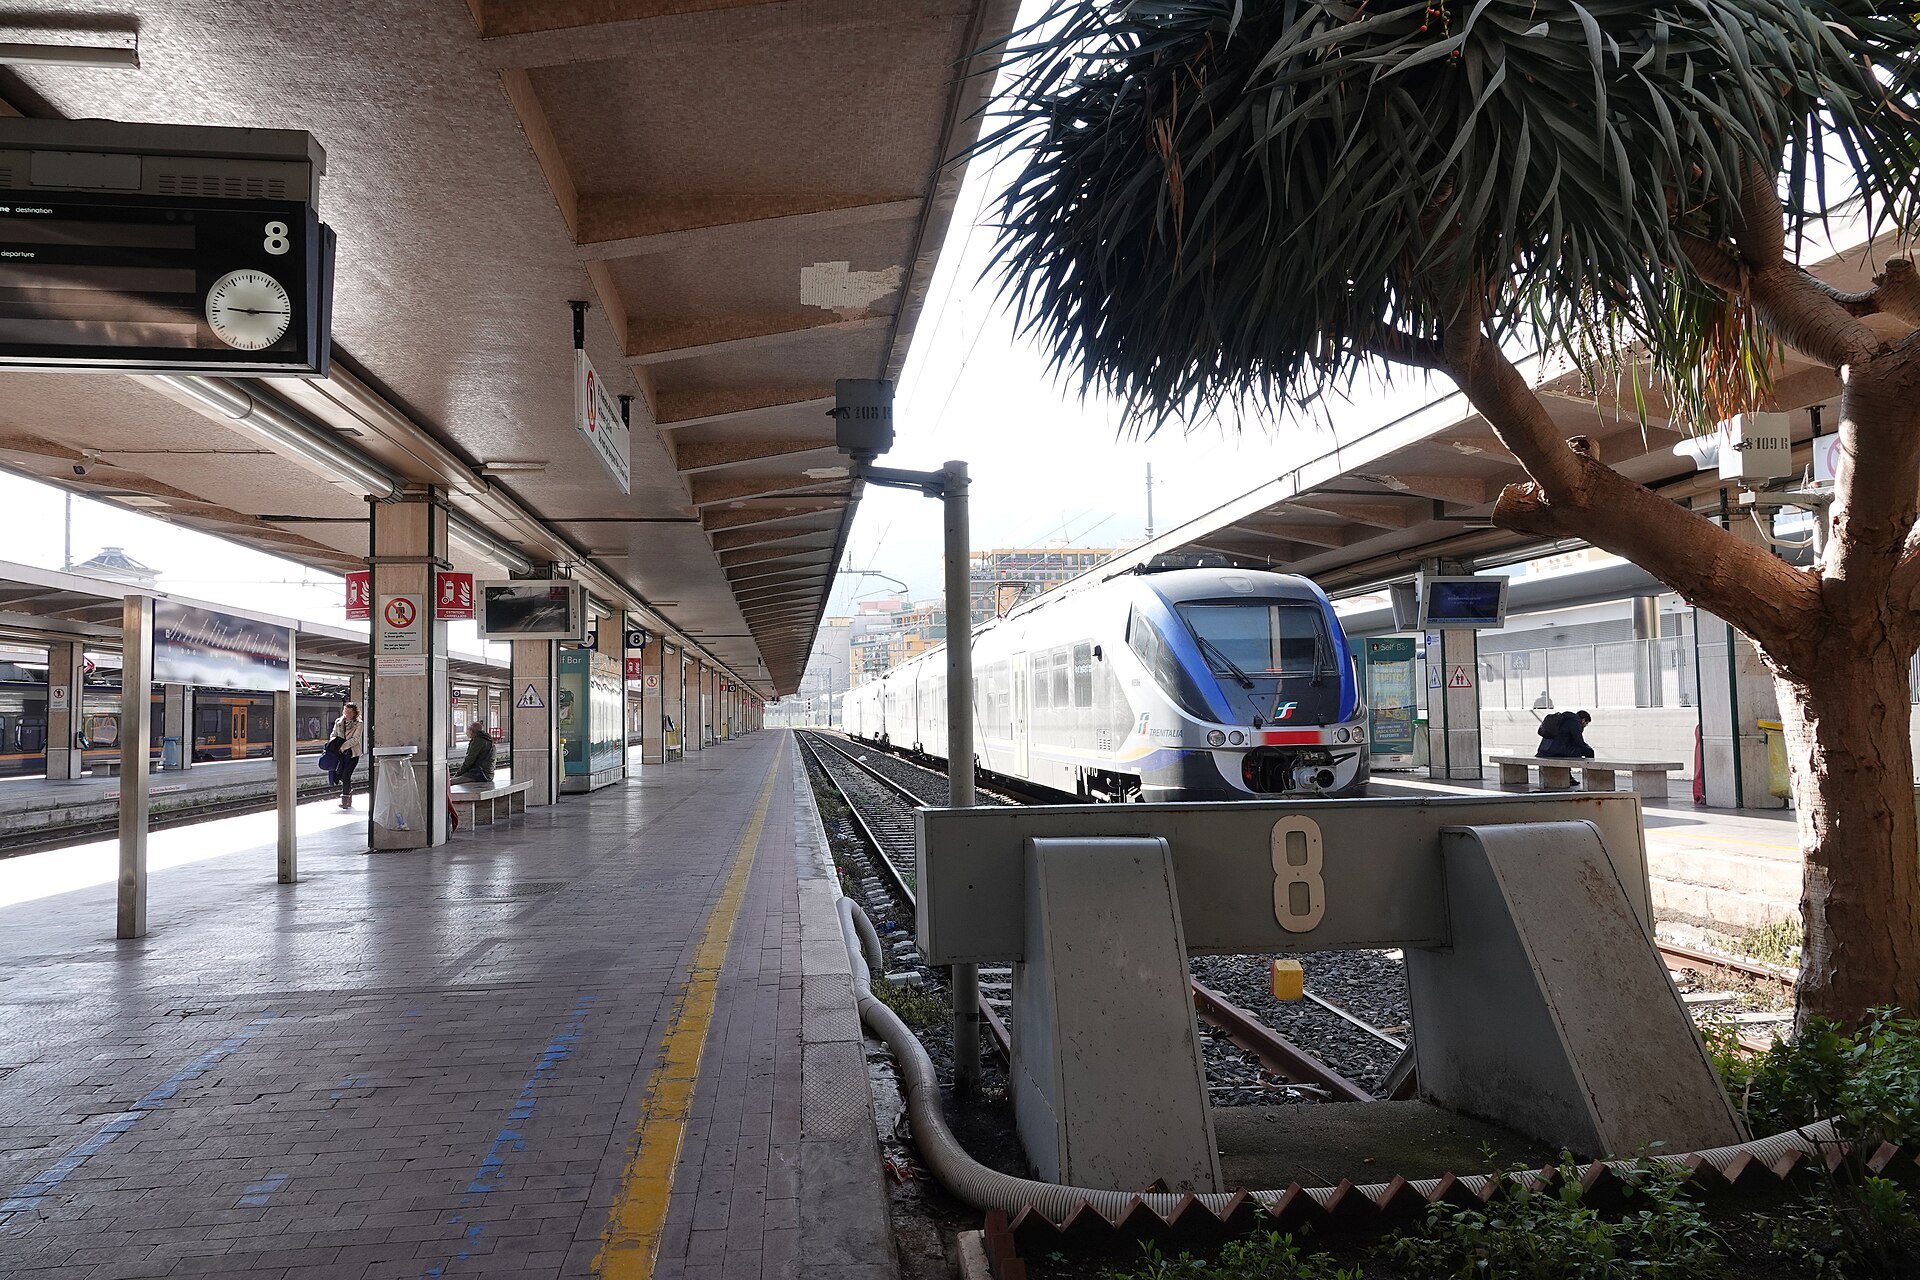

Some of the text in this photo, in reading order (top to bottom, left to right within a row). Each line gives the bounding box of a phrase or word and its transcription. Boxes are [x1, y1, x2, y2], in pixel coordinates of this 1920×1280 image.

[15, 206, 53, 214] destination
[263, 221, 290, 255] 8
[0, 250, 35, 258] departure
[1755, 437, 1777, 450] 109
[1781, 437, 1788, 450] R
[633, 635, 639, 643] 8
[1380, 643, 1409, 651] Self Bar
[567, 656, 581, 664] Bar
[1150, 728, 1184, 738] TRENITALIA
[1271, 814, 1326, 933] 8
